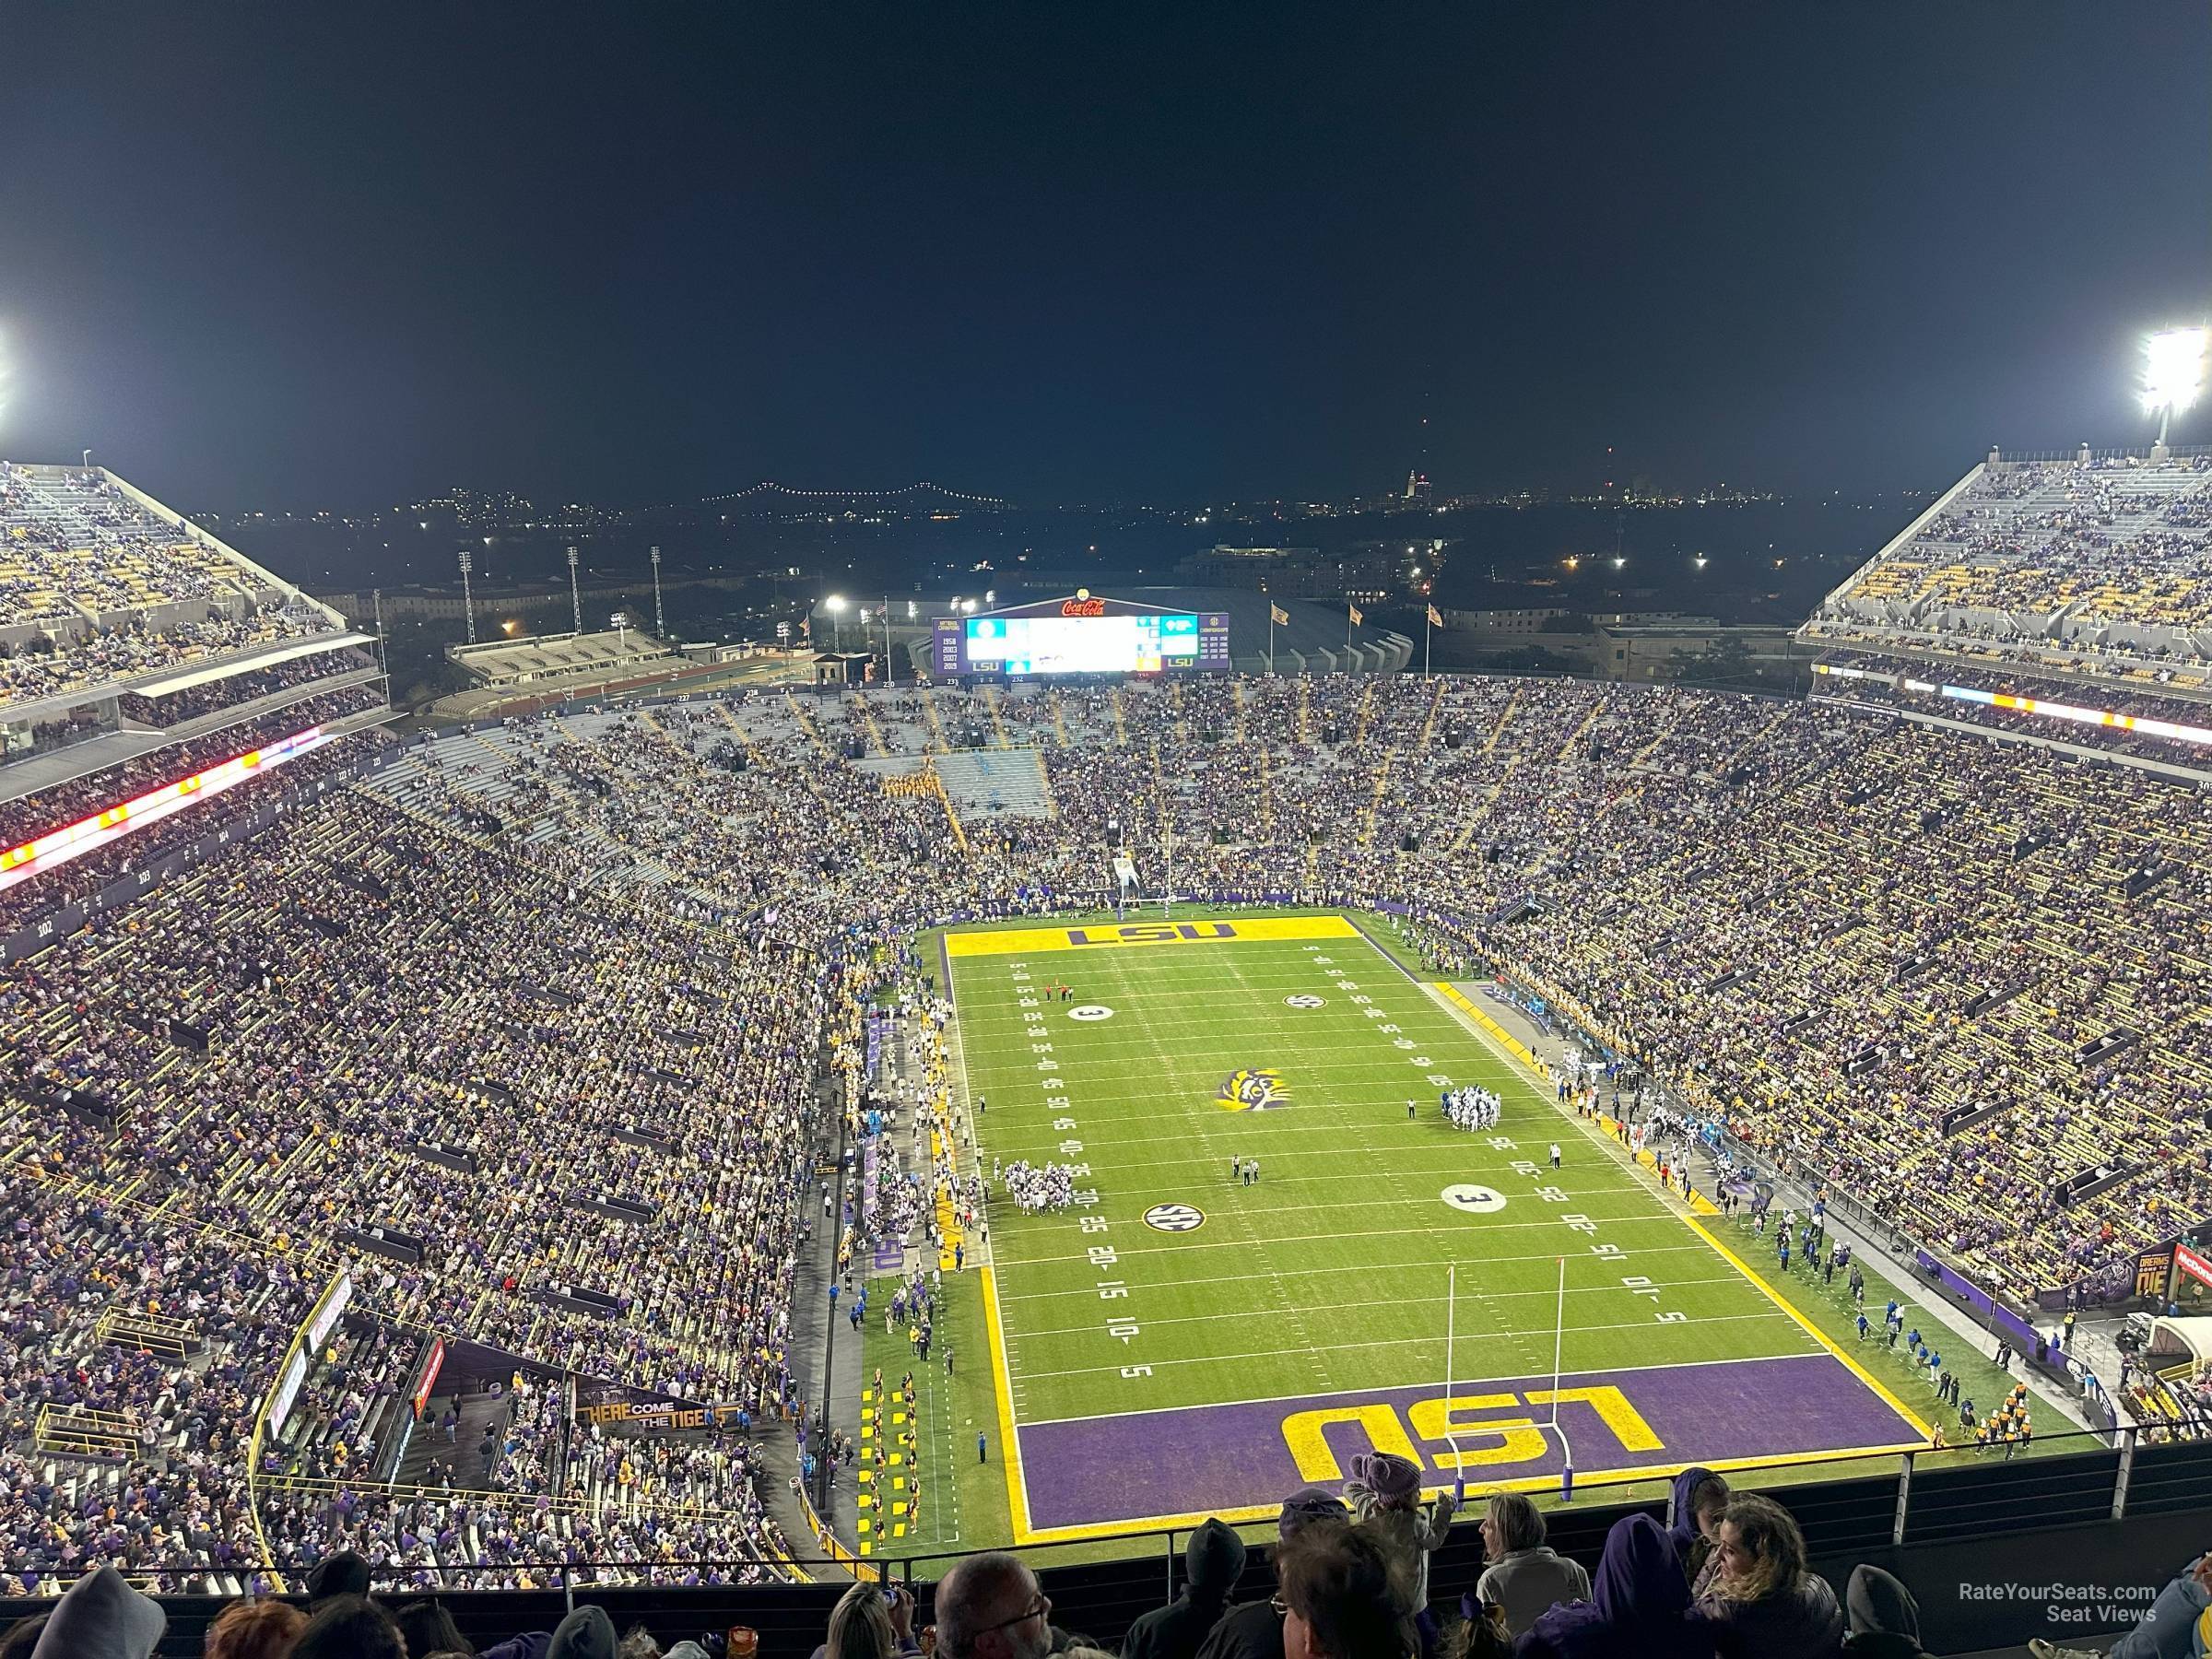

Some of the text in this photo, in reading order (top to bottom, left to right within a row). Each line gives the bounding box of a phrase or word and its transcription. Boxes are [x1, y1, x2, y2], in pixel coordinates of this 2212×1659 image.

[972, 663, 999, 672] LSU
[1167, 658, 1194, 667] LSU
[677, 694, 690, 702] 227
[1922, 723, 1934, 732] 300
[218, 830, 229, 843] 104
[138, 869, 150, 884] 103
[38, 920, 53, 938] 102
[1067, 924, 1237, 945] LSU
[1059, 1139, 1083, 1153] 40
[1509, 1160, 1543, 1176] 30
[1454, 1192, 1493, 1204] 3
[1534, 1186, 1570, 1202] 25
[1079, 1216, 1109, 1233] 25
[1560, 1214, 1598, 1231] 20
[1087, 1245, 1118, 1265] 20
[1589, 1243, 1628, 1261] 15
[2140, 1255, 2170, 1267] DREAMS
[1097, 1280, 1129, 1300] 15
[1620, 1276, 1661, 1294] 10
[2136, 1271, 2167, 1296] DIE
[1654, 1312, 1688, 1322] 5
[1106, 1316, 1140, 1337] 10
[1120, 1365, 1153, 1379] 5
[590, 1402, 675, 1423] HERE COME
[639, 1408, 726, 1429] THE TIGES
[1282, 1385, 1665, 1483] LSU
